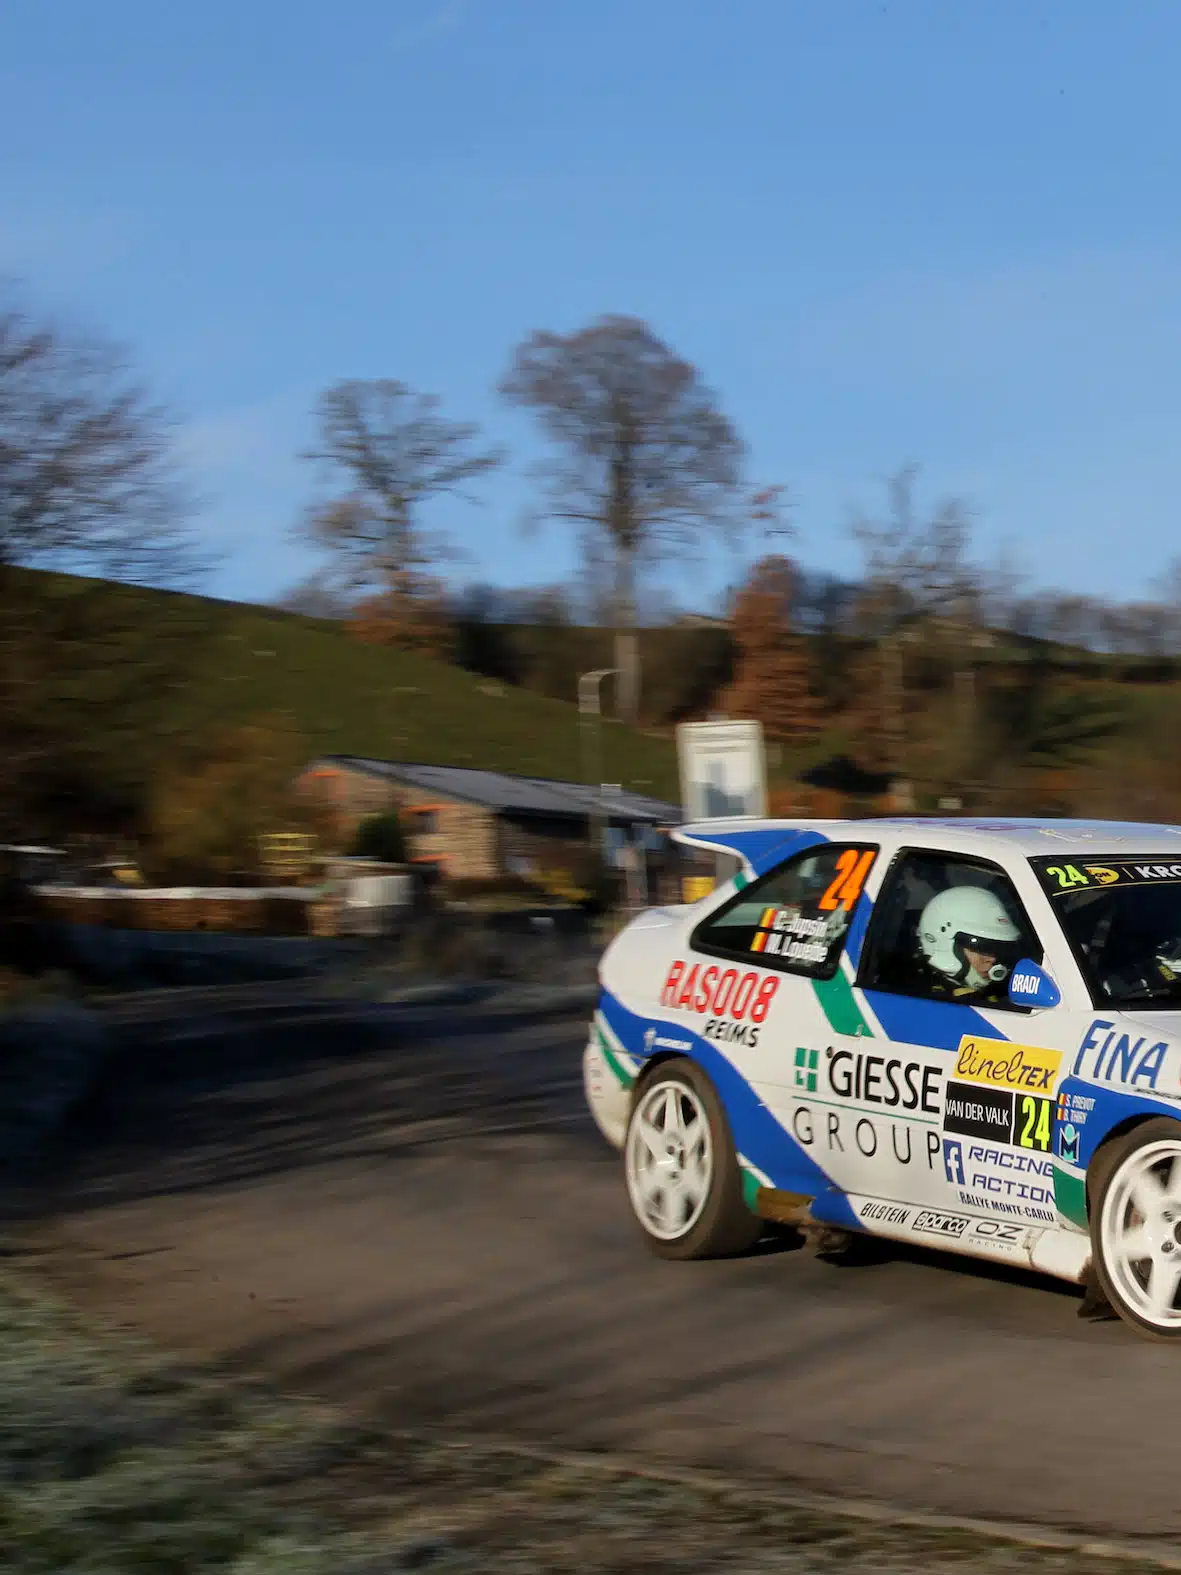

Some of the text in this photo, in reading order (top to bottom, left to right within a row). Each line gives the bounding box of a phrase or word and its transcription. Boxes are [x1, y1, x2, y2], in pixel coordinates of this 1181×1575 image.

[817, 849, 876, 912] 24
[1045, 864, 1089, 888] 24
[1011, 974, 1041, 994] BRADI
[703, 1019, 761, 1047] REIMS
[1073, 1019, 1169, 1088] FINA
[828, 1050, 943, 1114] GIESSE
[946, 1099, 1009, 1126] VAN DER VALK
[1020, 1096, 1051, 1151] 24
[793, 1106, 941, 1170] GROUP
[860, 1202, 911, 1224] BILSTEIN
[959, 1191, 990, 1208] RALLYE
[975, 1221, 1024, 1240] OZ
